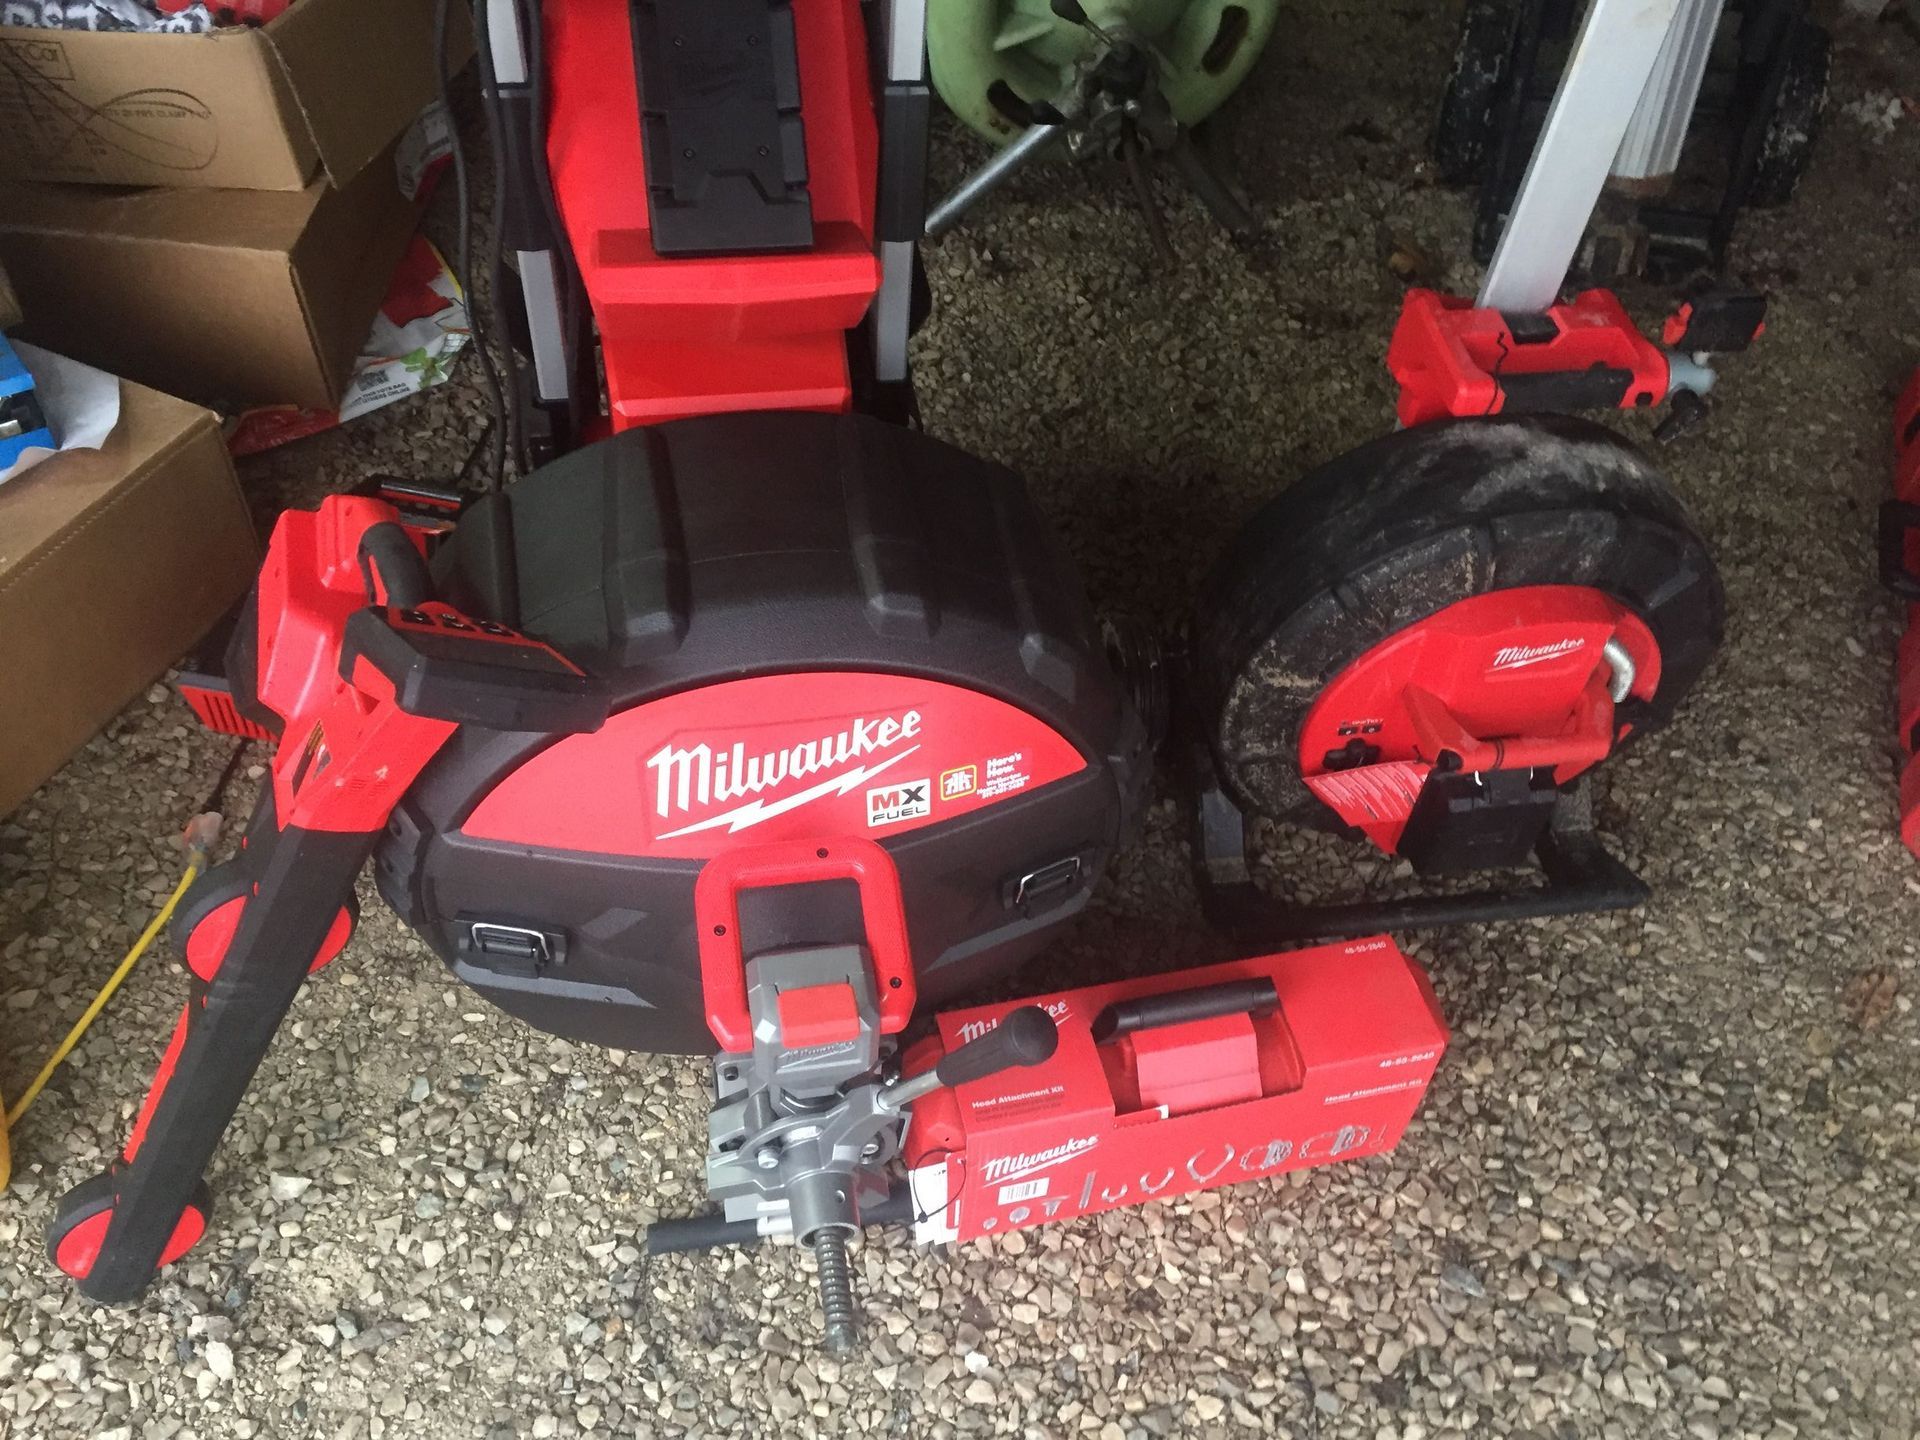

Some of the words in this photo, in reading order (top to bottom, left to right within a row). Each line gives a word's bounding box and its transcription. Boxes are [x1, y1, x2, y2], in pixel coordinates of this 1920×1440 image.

[1493, 638, 1585, 666] Milwaukee
[646, 710, 922, 818] Milwaukee
[872, 785, 926, 811] MX
[872, 806, 927, 824] FUEL
[972, 1098, 997, 1109] Head
[998, 1089, 1050, 1104] Attachment
[1051, 1085, 1065, 1094] Kit
[979, 1135, 1099, 1181] Milwaukee
